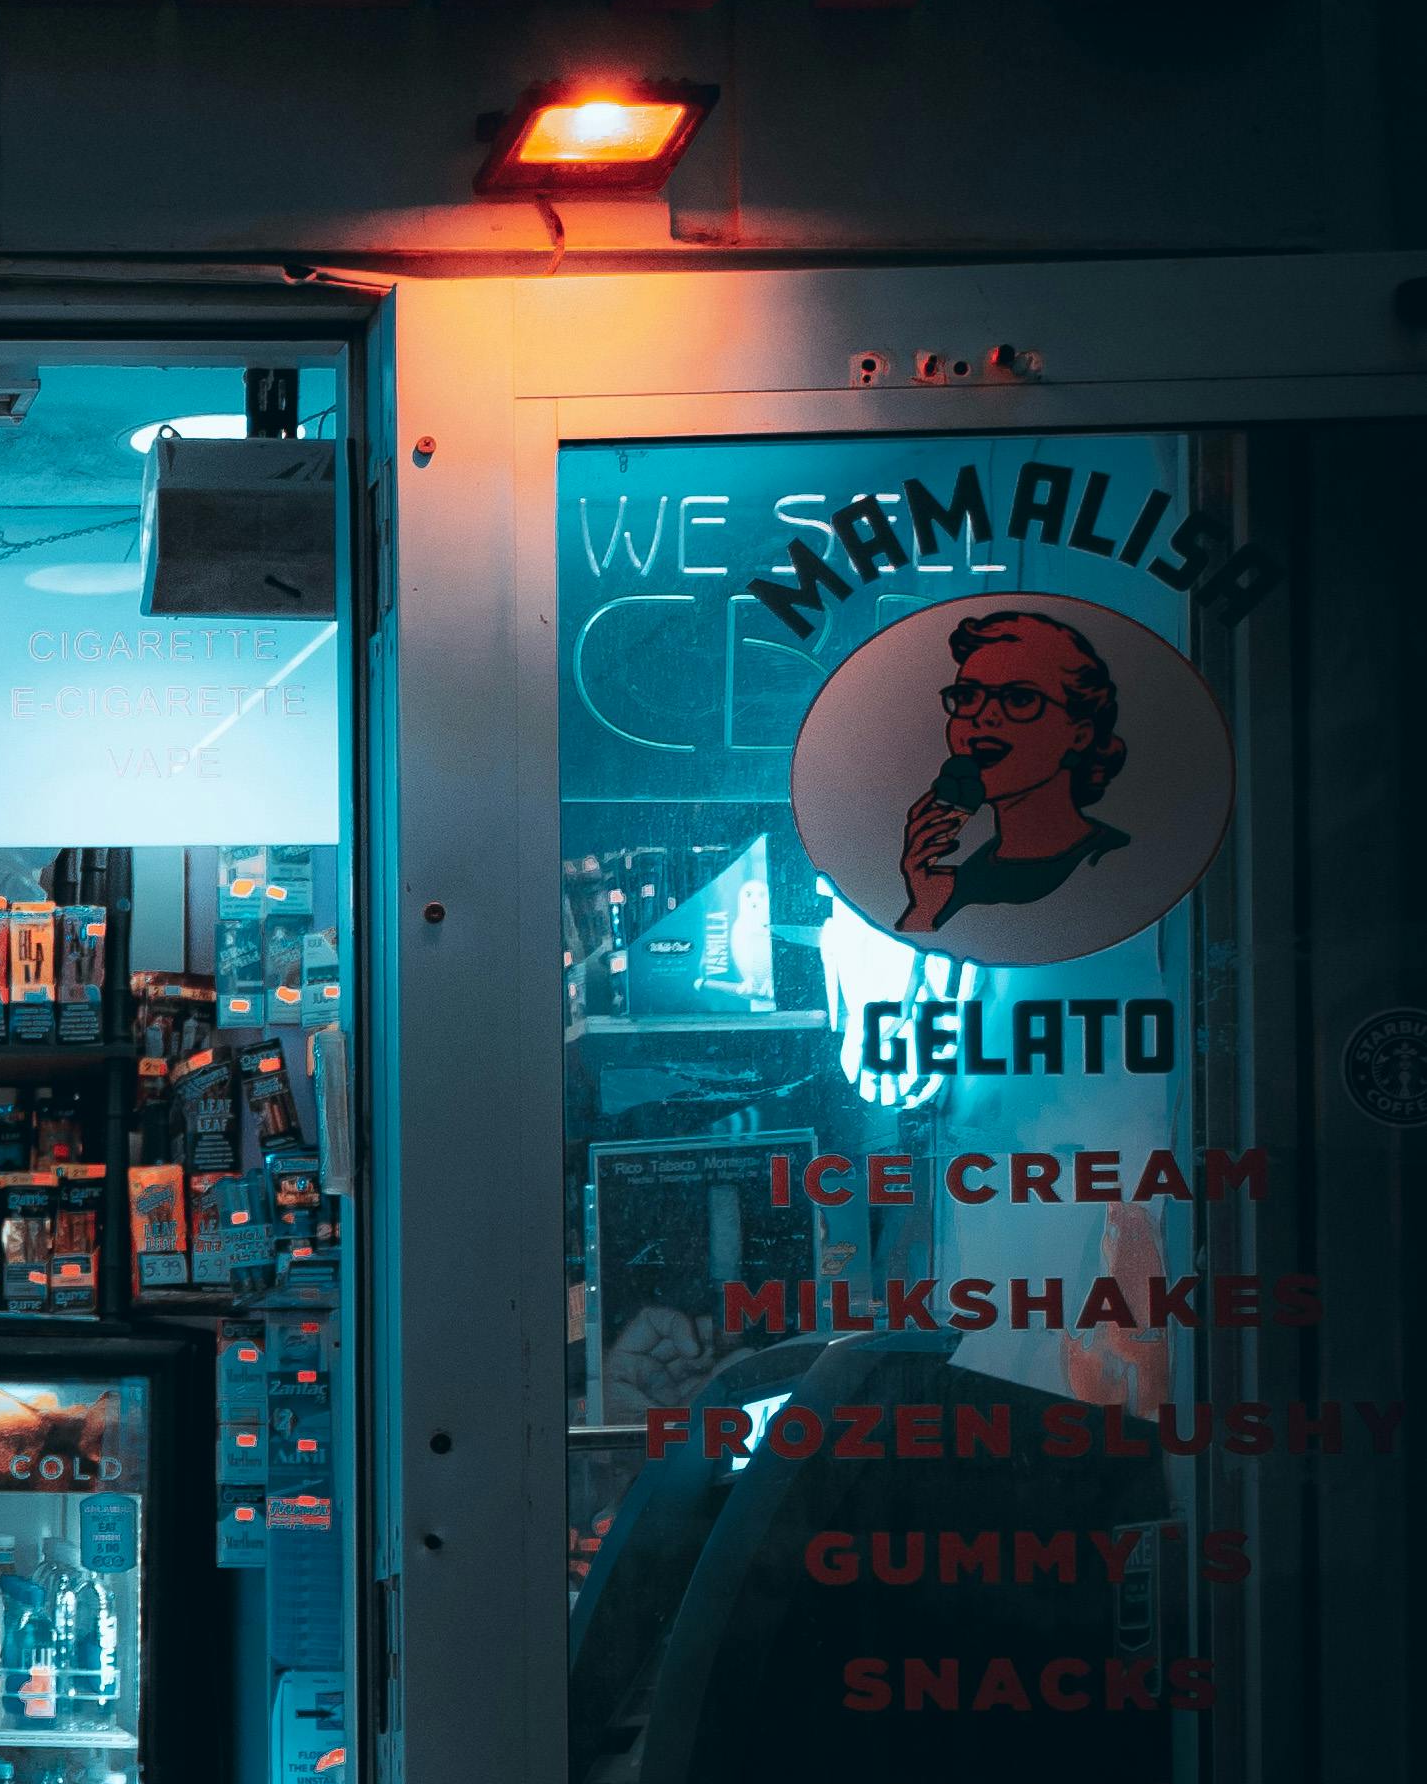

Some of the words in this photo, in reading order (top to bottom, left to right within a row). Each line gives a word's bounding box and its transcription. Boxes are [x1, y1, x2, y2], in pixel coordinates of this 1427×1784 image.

[579, 494, 729, 577] WE
[746, 461, 1289, 641] MAMALISA
[28, 627, 279, 663] CIGARETTE
[9, 685, 308, 720] E-CIGARETTE
[106, 745, 224, 780] VAPE
[862, 997, 1176, 1077] GELATO
[1354, 1019, 1427, 1064] STARBU
[1366, 1088, 1427, 1116] COFFE
[769, 1153, 916, 1208] ICE
[944, 1148, 1272, 1206] CREAM
[723, 1274, 1325, 1335] MILKSHAKES
[269, 1380, 328, 1397] Zantac
[644, 1403, 1013, 1462] FROZEN
[1040, 1401, 1411, 1459] SLUSHY
[9, 1455, 124, 1481] COLD
[842, 1656, 1218, 1714] SNACKS
